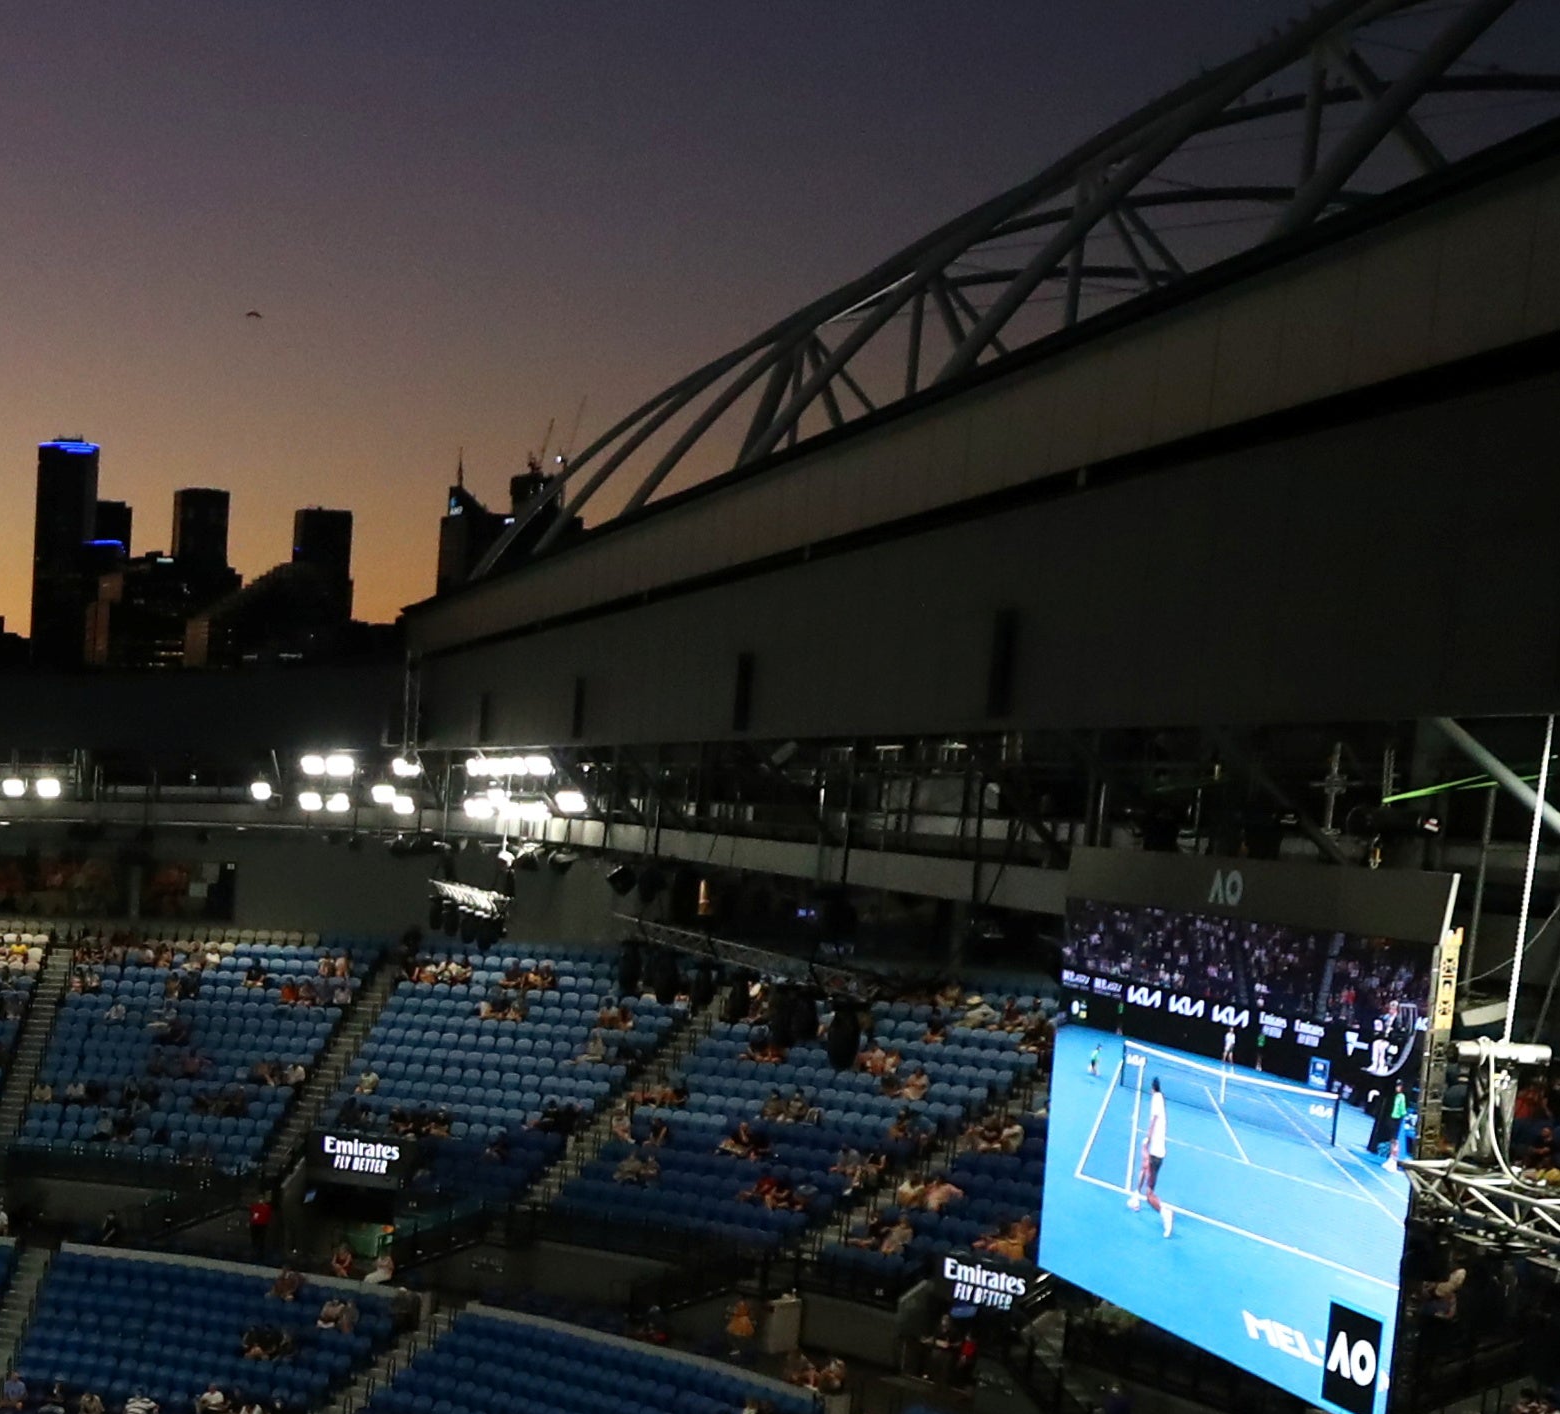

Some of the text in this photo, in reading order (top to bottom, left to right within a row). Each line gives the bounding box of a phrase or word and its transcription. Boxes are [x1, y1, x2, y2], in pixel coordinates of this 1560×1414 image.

[1208, 869, 1243, 905] AO
[1127, 985, 1162, 1011] KIA
[1168, 994, 1204, 1018] KIA
[1212, 1004, 1249, 1029] KIA
[324, 1135, 400, 1161] Emirates
[943, 1257, 1026, 1296] Emirates
[1327, 1330, 1377, 1387] AO
